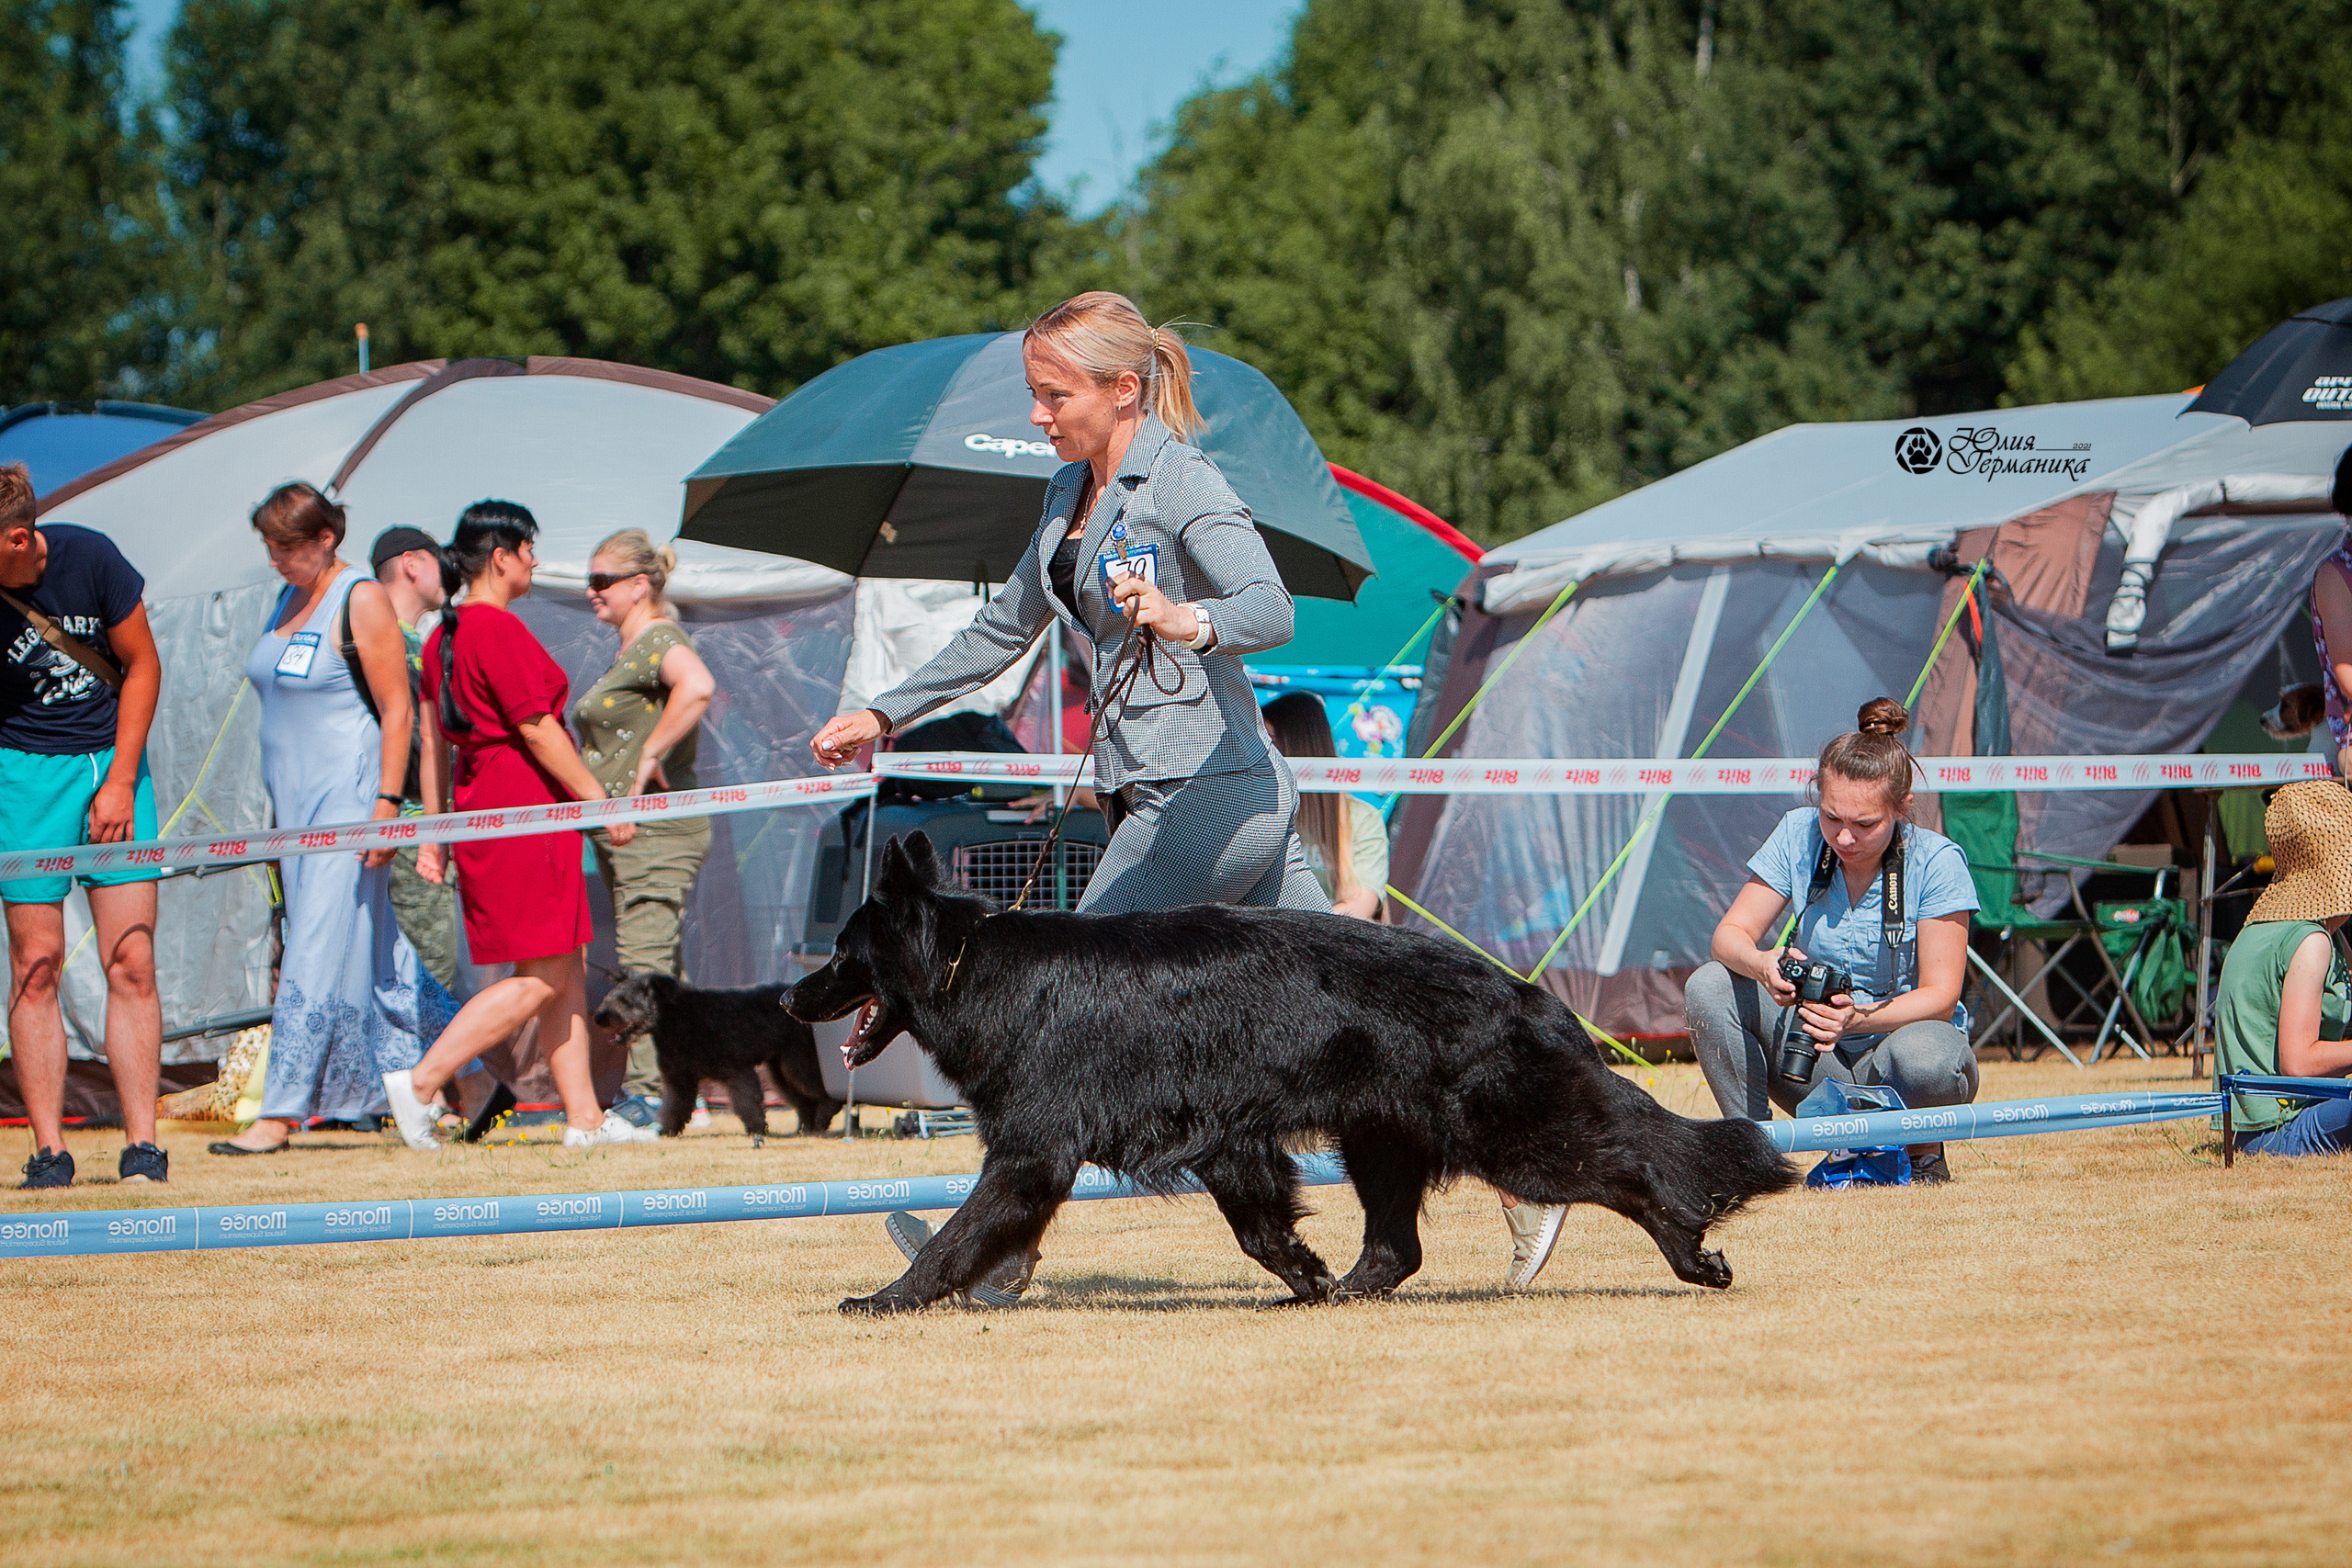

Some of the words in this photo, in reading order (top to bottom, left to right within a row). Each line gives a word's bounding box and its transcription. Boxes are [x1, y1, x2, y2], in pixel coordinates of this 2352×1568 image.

[7, 615, 101, 663] LEGARY
[1325, 769, 1361, 784] Blitz
[1408, 769, 1444, 784] Blitz
[1485, 770, 1519, 784] Blitz
[1566, 769, 1600, 784] Blitz
[1639, 769, 1673, 784] Blitz
[1718, 768, 1751, 784] Blitz
[1790, 768, 1816, 783] litz
[1939, 767, 1971, 782] Blitz
[2016, 766, 2048, 781] Blitz
[2085, 765, 2117, 780] Blitz
[2161, 764, 2193, 780] Blitz
[2229, 763, 2261, 778] Blitz
[632, 795, 669, 812] Blitz
[467, 814, 504, 830] Blitz
[546, 806, 582, 822] Blitz
[300, 830, 337, 848] Blitz
[379, 823, 416, 840] Blitz
[127, 847, 165, 864] Blitz
[209, 840, 247, 857] Blitz
[35, 856, 74, 872] Blitz
[1821, 846, 1832, 870] Can
[1888, 872, 1898, 910] Canon
